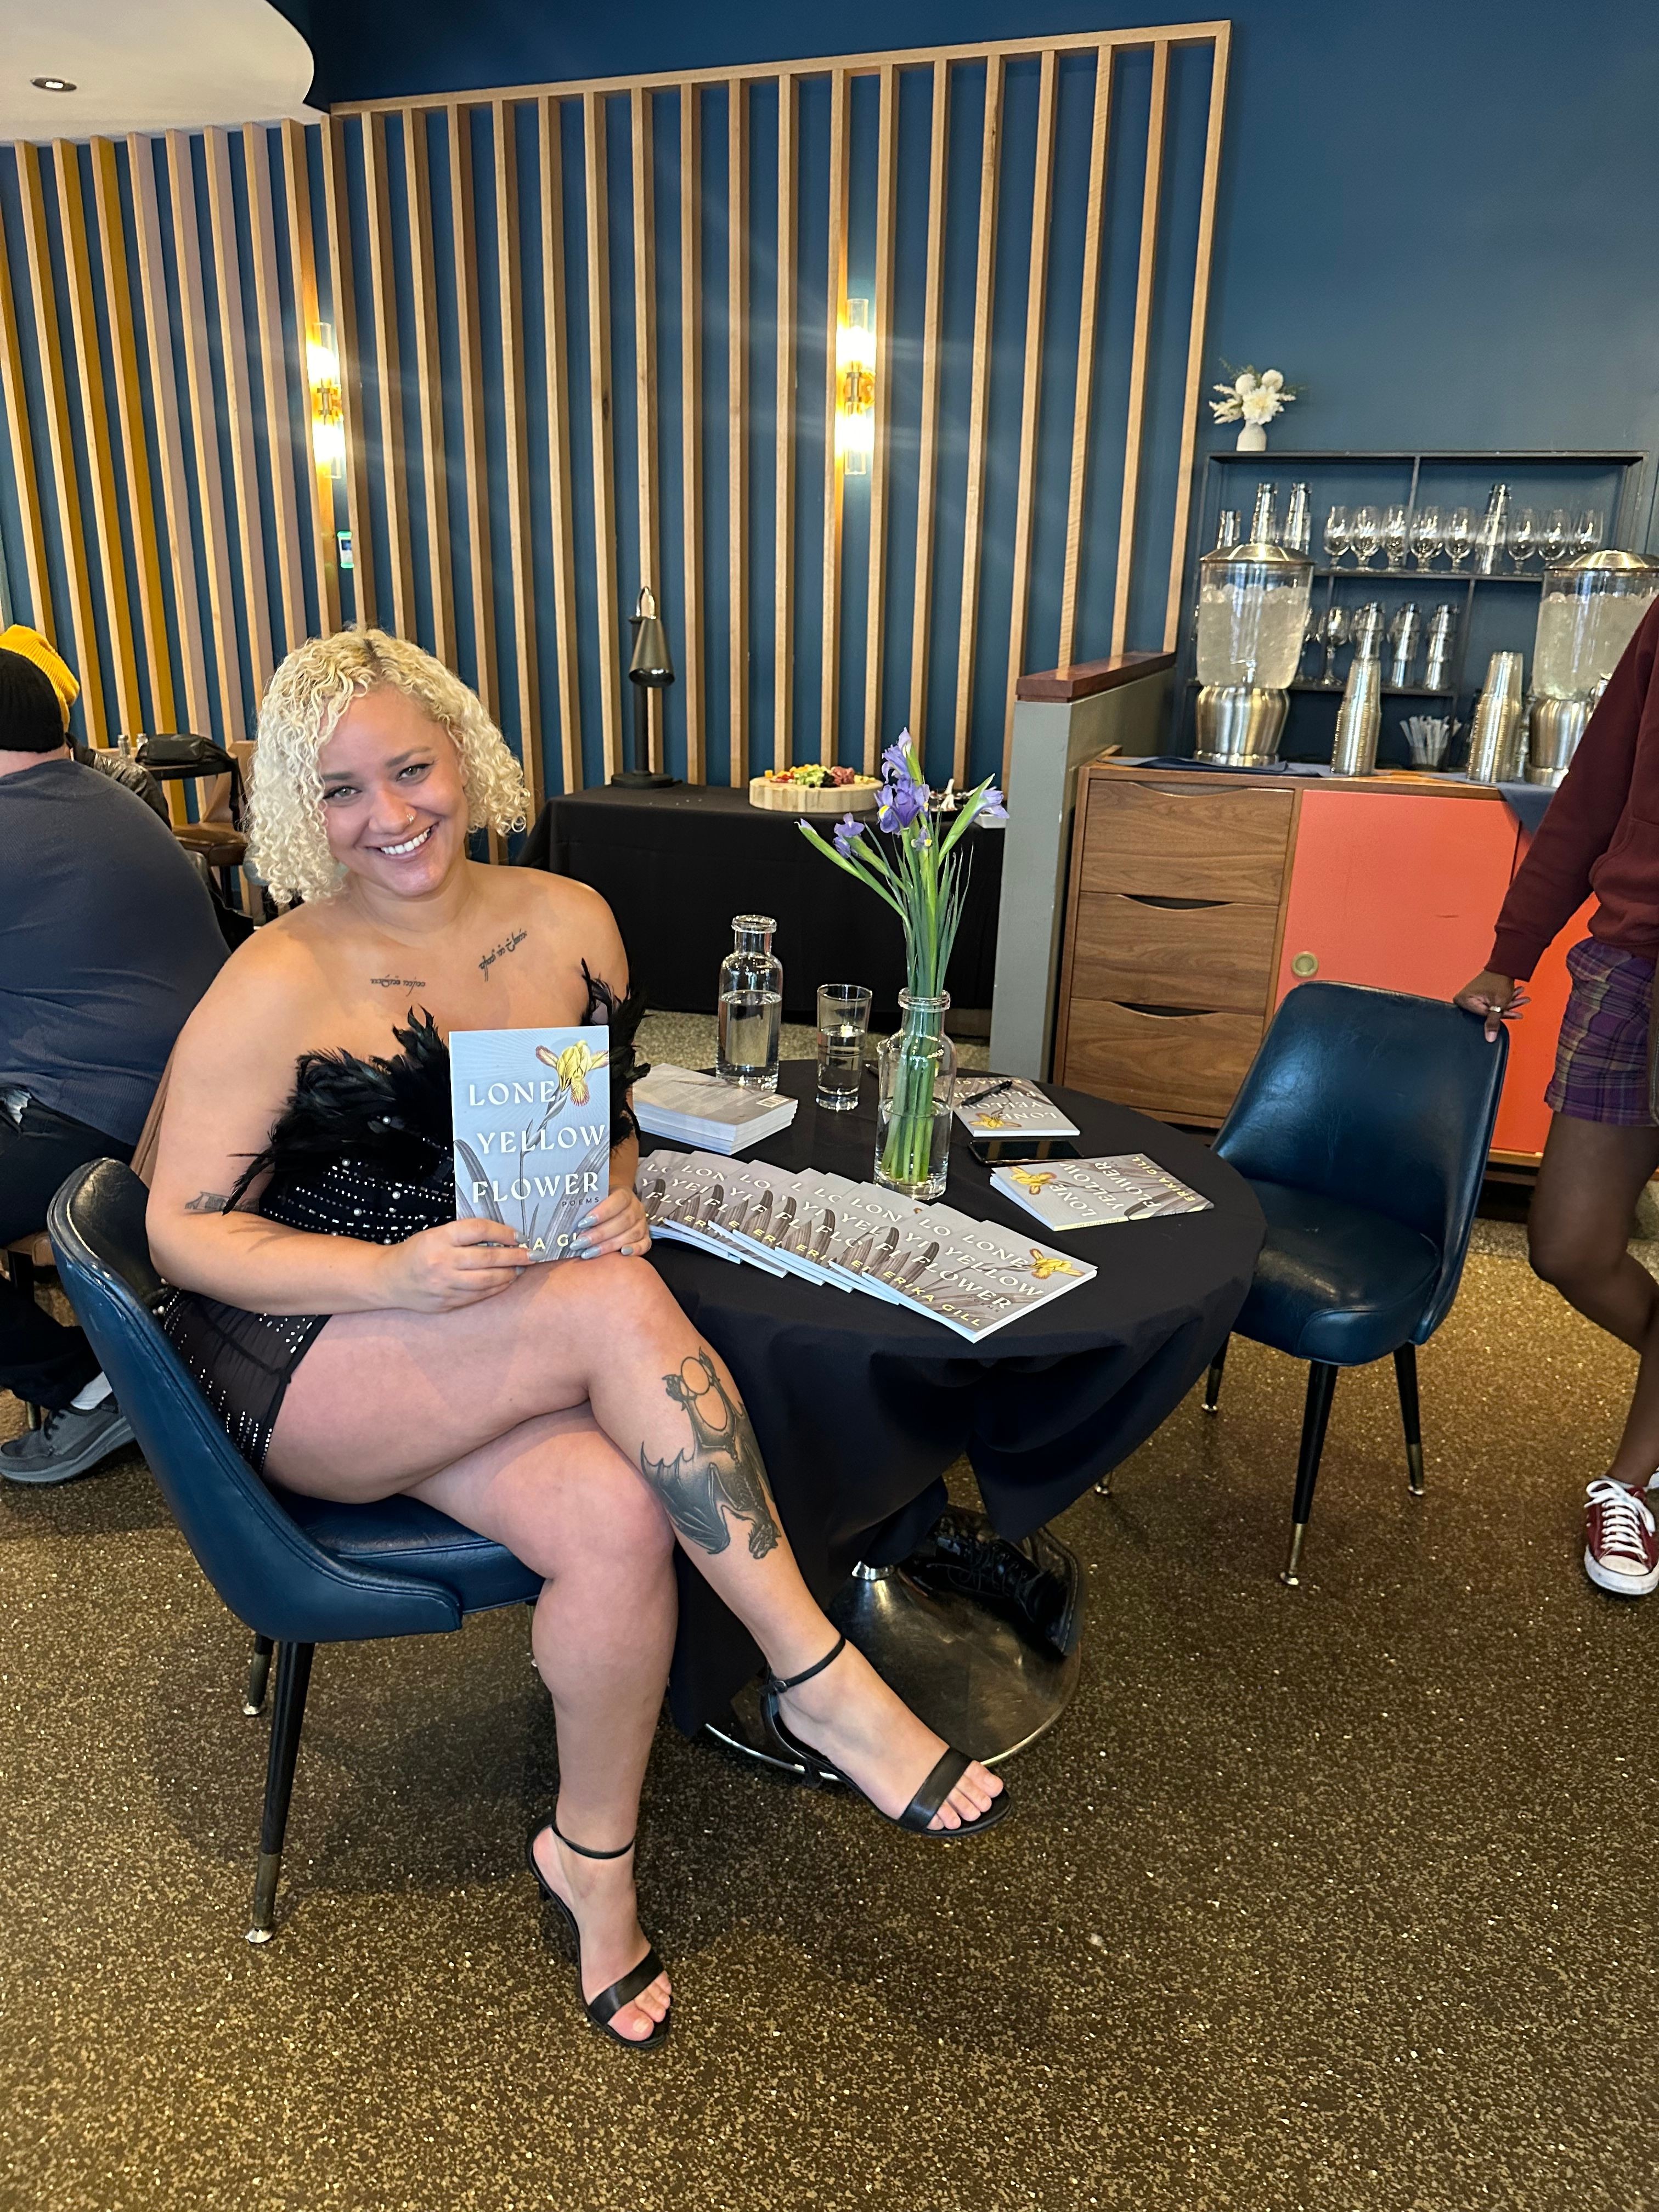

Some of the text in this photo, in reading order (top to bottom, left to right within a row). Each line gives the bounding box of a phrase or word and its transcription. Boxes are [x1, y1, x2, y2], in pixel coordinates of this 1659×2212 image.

[469, 1080, 556, 1107] LONE
[998, 1112, 1058, 1120] LONE
[476, 1124, 605, 1154] YELLOW
[1132, 1156, 1157, 1176] GILL
[473, 1172, 599, 1203] FLOWER
[740, 1174, 771, 1189] LO
[1059, 1164, 1124, 1210] YELLOW
[1094, 1161, 1161, 1208] FLOWER
[1159, 1177, 1195, 1202] ERIKA
[561, 1197, 600, 1207] POEMS
[851, 1198, 903, 1222] LON
[1049, 1183, 1097, 1216] LONE
[918, 1218, 951, 1236] LO
[962, 1234, 1029, 1267] LONE
[911, 1255, 1012, 1310] FLOWER
[945, 1246, 1044, 1296] YELLOW
[883, 1271, 981, 1327] ERIKA GILL
